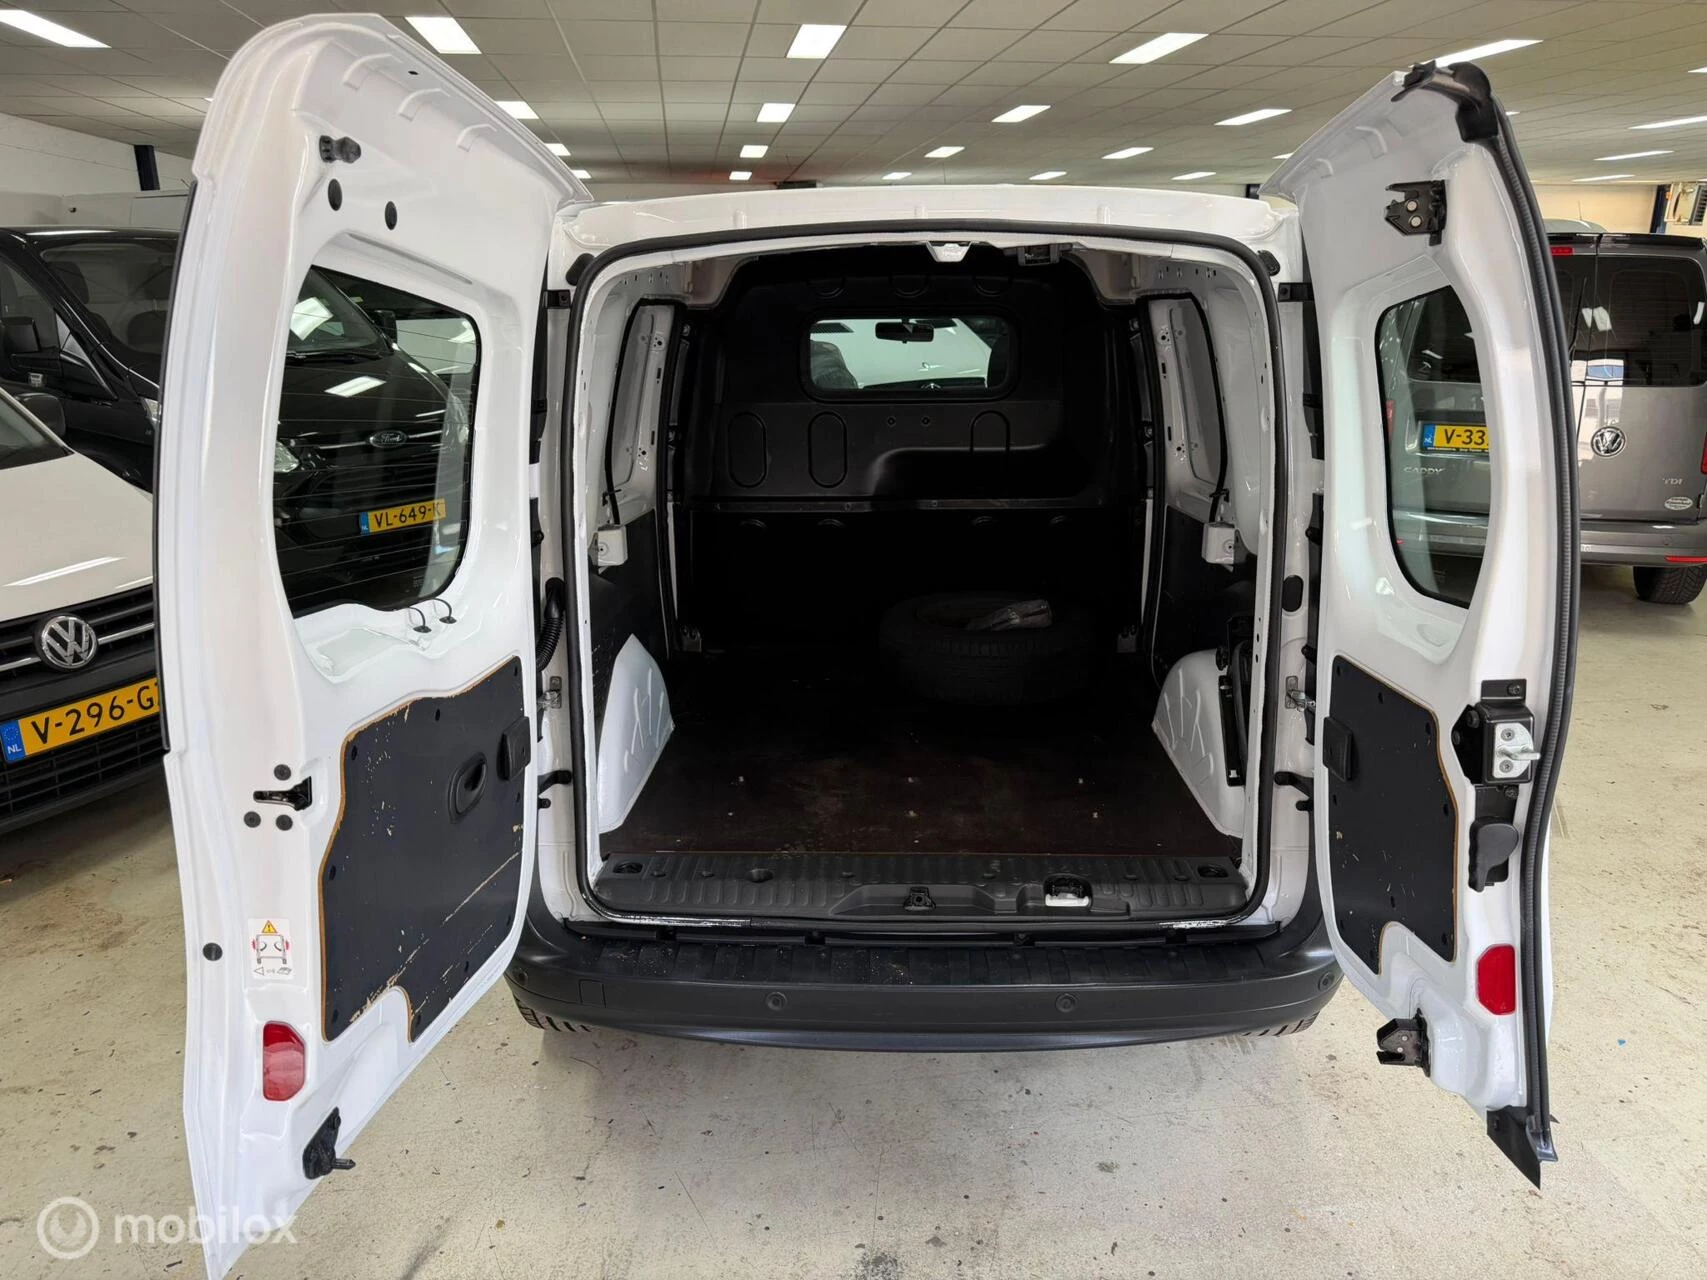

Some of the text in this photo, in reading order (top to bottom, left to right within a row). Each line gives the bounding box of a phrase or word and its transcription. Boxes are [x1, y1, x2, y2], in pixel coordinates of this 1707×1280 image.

[1444, 428, 1489, 446] V-33
[374, 502, 442, 528] VL-649-K
[31, 682, 159, 744] V-296-G
[7, 744, 22, 754] NL
